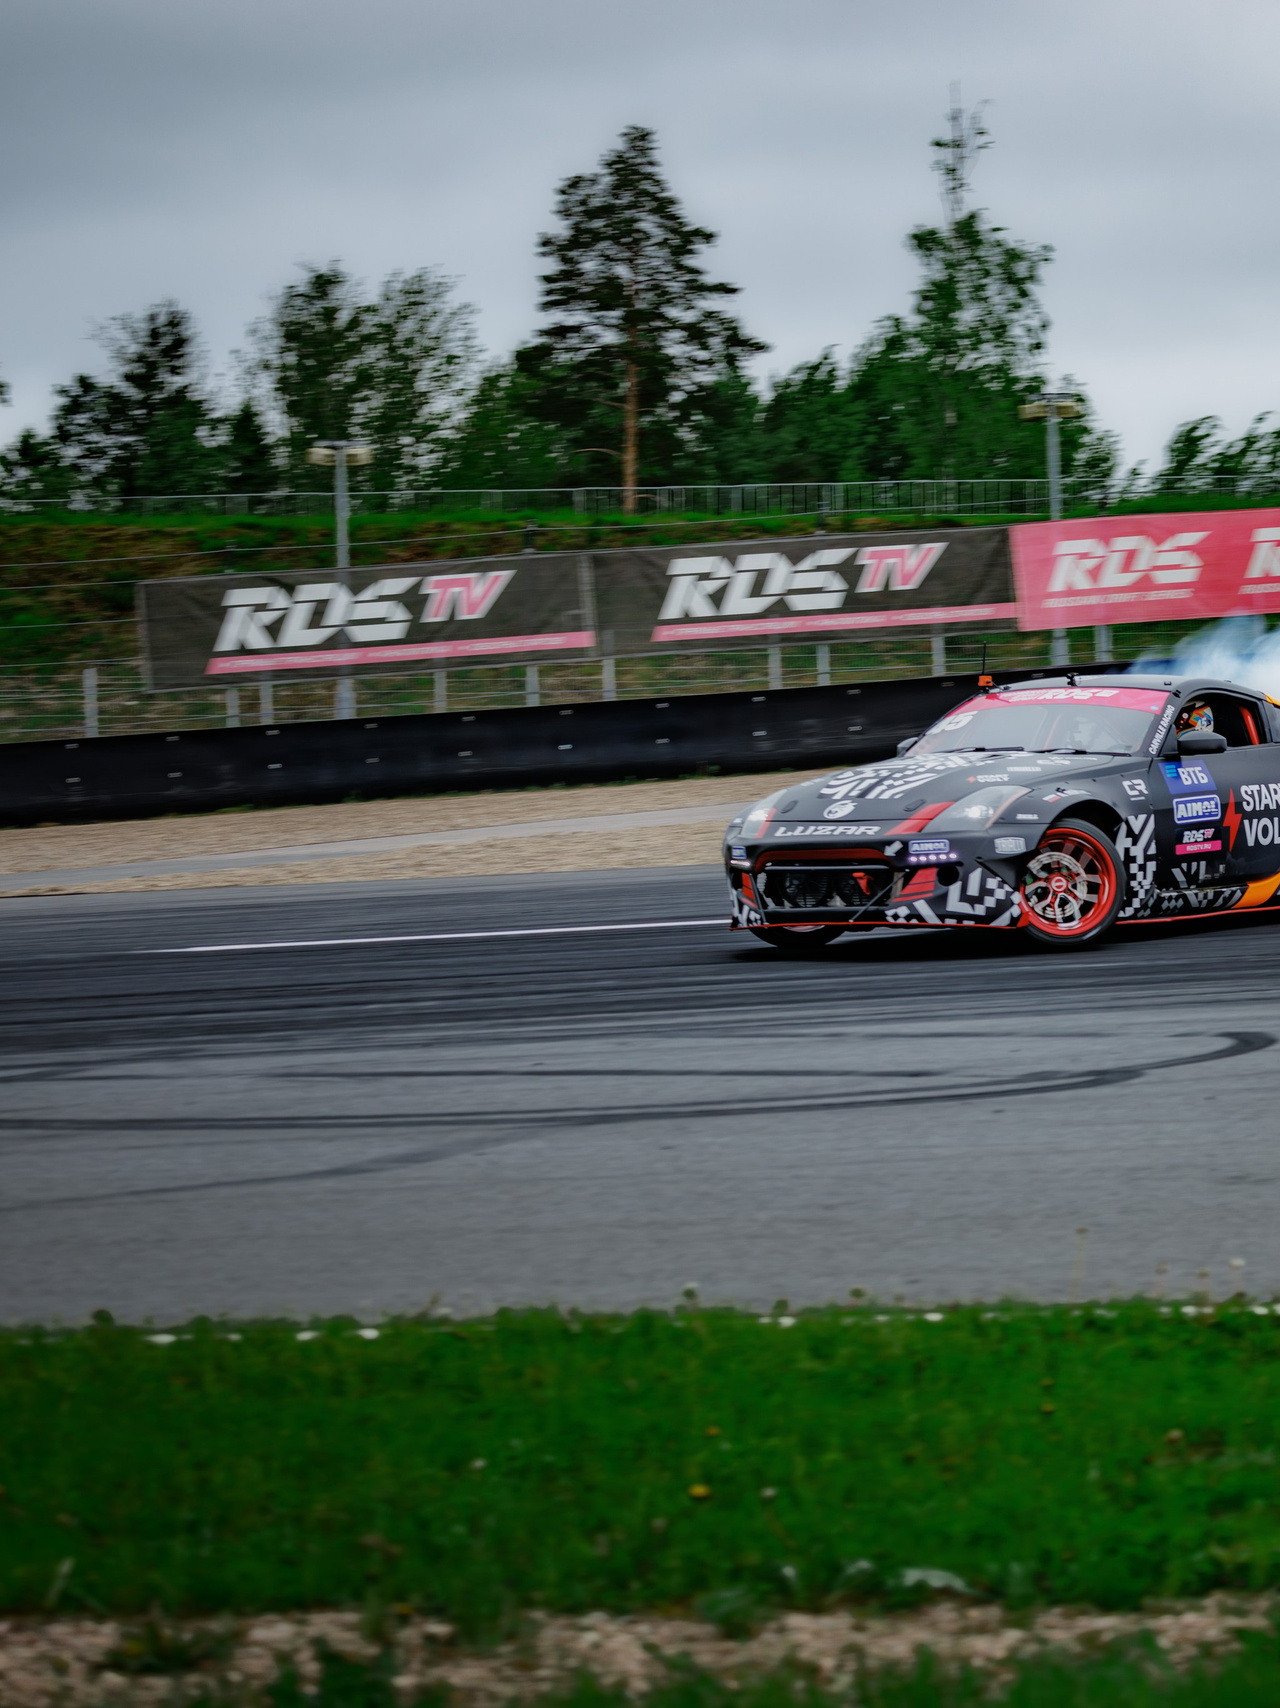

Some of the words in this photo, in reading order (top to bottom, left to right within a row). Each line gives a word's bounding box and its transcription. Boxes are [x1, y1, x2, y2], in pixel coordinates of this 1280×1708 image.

[1046, 531, 1212, 592] RDS
[658, 548, 859, 619] RDS
[854, 542, 949, 593] TV
[213, 577, 421, 652] RDS
[418, 570, 517, 623] TV
[1148, 726, 1167, 755] CARVILLE
[1177, 767, 1208, 786] ВТБ
[1177, 800, 1219, 819] AIMOL
[774, 825, 881, 837] LUZAR
[1182, 829, 1204, 843] RDS
